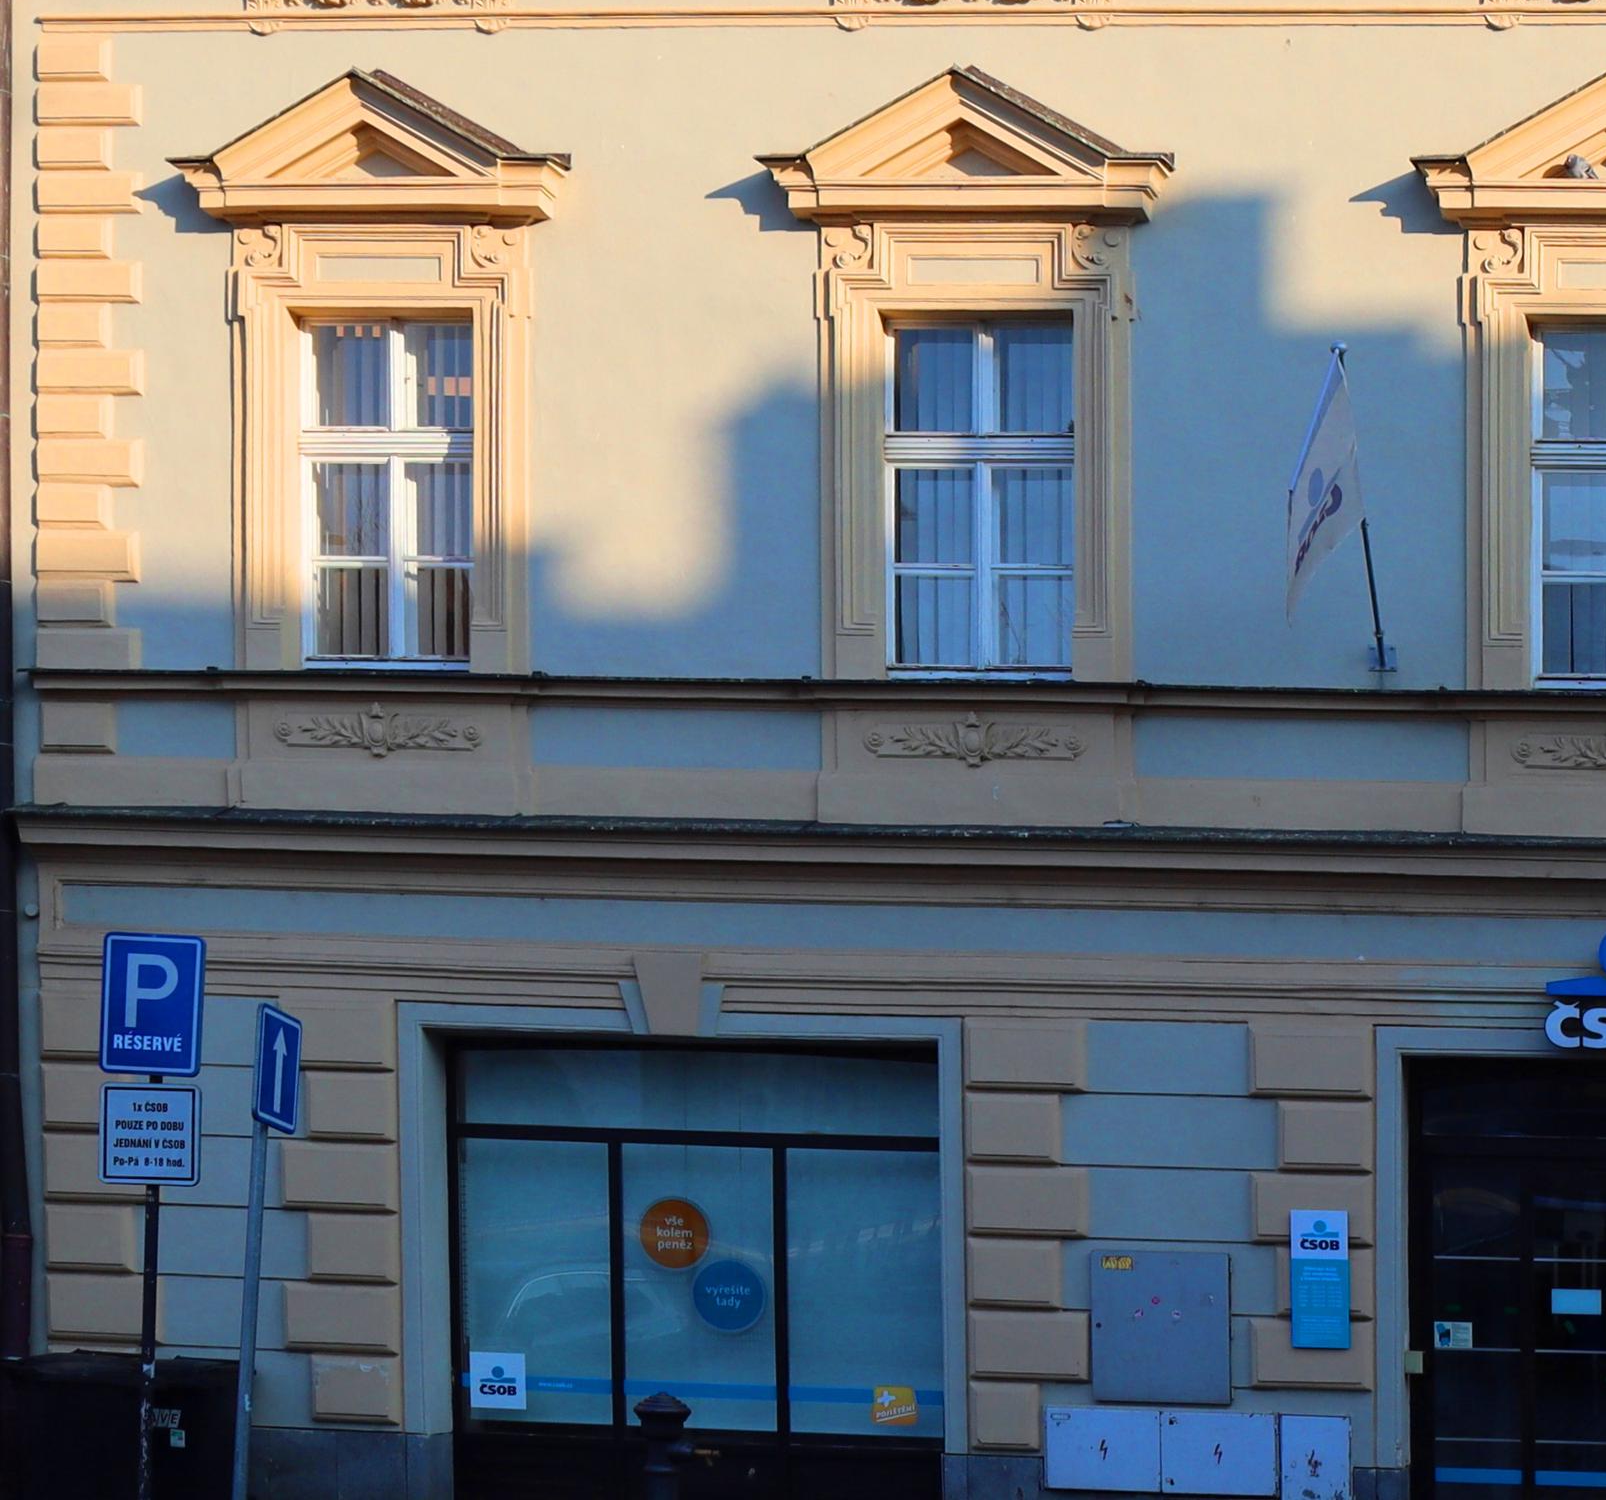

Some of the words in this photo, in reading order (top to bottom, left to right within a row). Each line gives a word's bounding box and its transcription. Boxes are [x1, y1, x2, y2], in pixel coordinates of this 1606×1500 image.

[124, 952, 179, 1028] P
[113, 1030, 183, 1053] RÉSERVÉ
[132, 1102, 142, 1113] 1x
[144, 1100, 168, 1113] ČSOB
[115, 1120, 144, 1131] POUZE
[146, 1121, 158, 1131] PO
[160, 1121, 184, 1132] DOBU
[113, 1137, 152, 1149] JEDNÁNÍ
[153, 1139, 160, 1149] V
[161, 1137, 186, 1150] ČSOB
[113, 1156, 139, 1167] Po-Pá
[144, 1156, 164, 1167] 8-18
[166, 1156, 186, 1168] hod.
[664, 1215, 684, 1226] vše
[656, 1227, 693, 1238] kolem
[657, 1240, 693, 1252] peněz
[1300, 1237, 1340, 1251] ČSOB
[716, 1297, 741, 1309] tady
[479, 1383, 517, 1396] ČSOB
